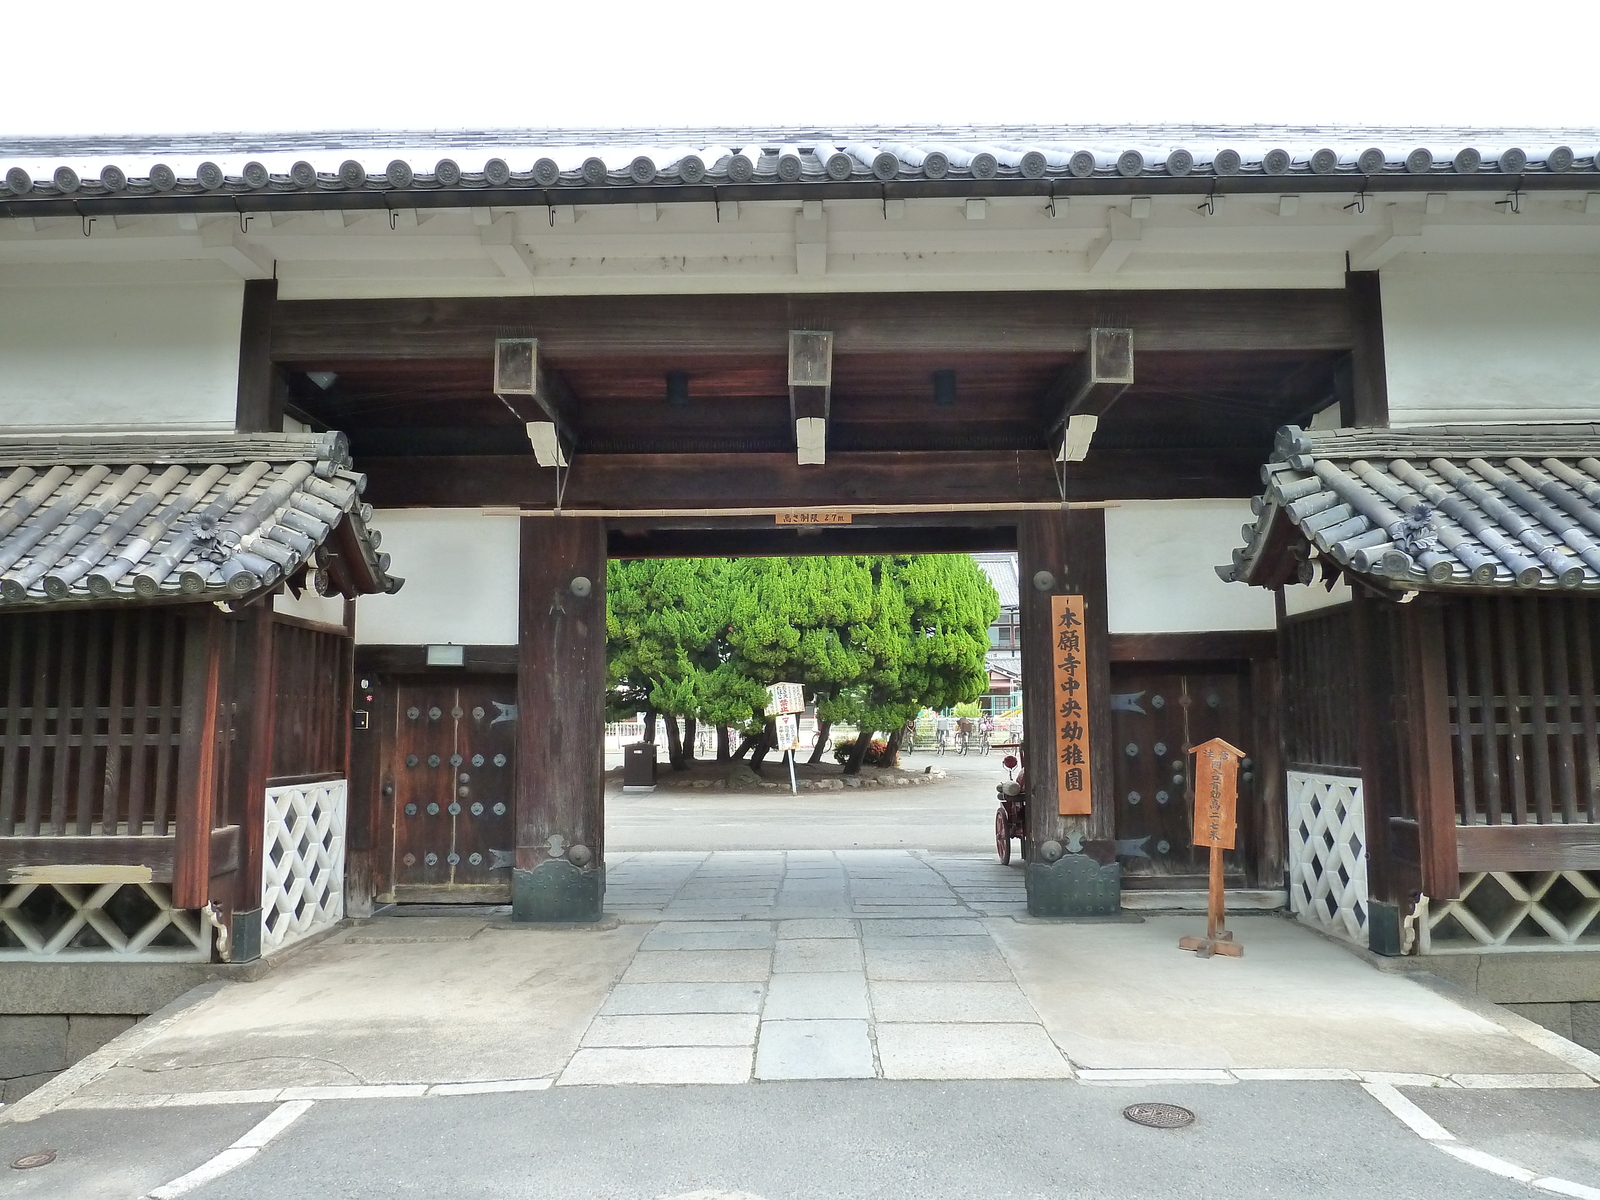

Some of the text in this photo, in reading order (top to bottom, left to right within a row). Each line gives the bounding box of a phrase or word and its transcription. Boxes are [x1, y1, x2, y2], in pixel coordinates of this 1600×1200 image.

[783, 513, 819, 523] 高さ制限
[779, 699, 789, 713] 禁止
[1058, 607, 1085, 792] 本願寺中央幼稚園
